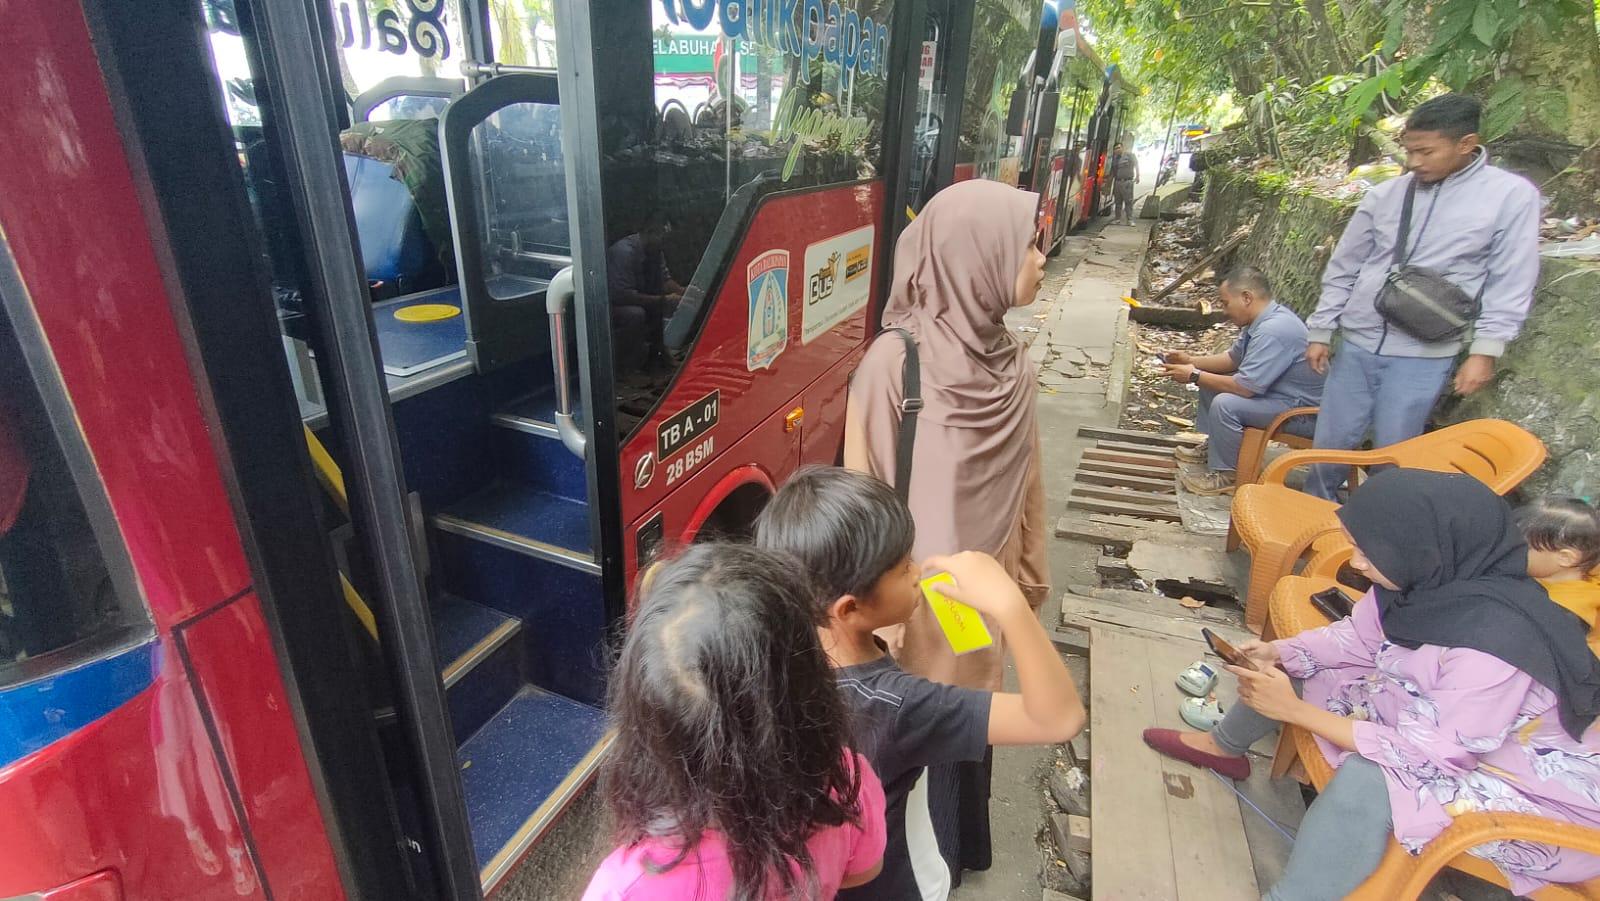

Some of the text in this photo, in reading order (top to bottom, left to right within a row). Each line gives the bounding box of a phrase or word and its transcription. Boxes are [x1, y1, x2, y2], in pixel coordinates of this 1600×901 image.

[661, 423, 680, 450] TB
[683, 415, 694, 437] A
[704, 399, 717, 422] 01
[666, 435, 714, 486] 28 BSM
